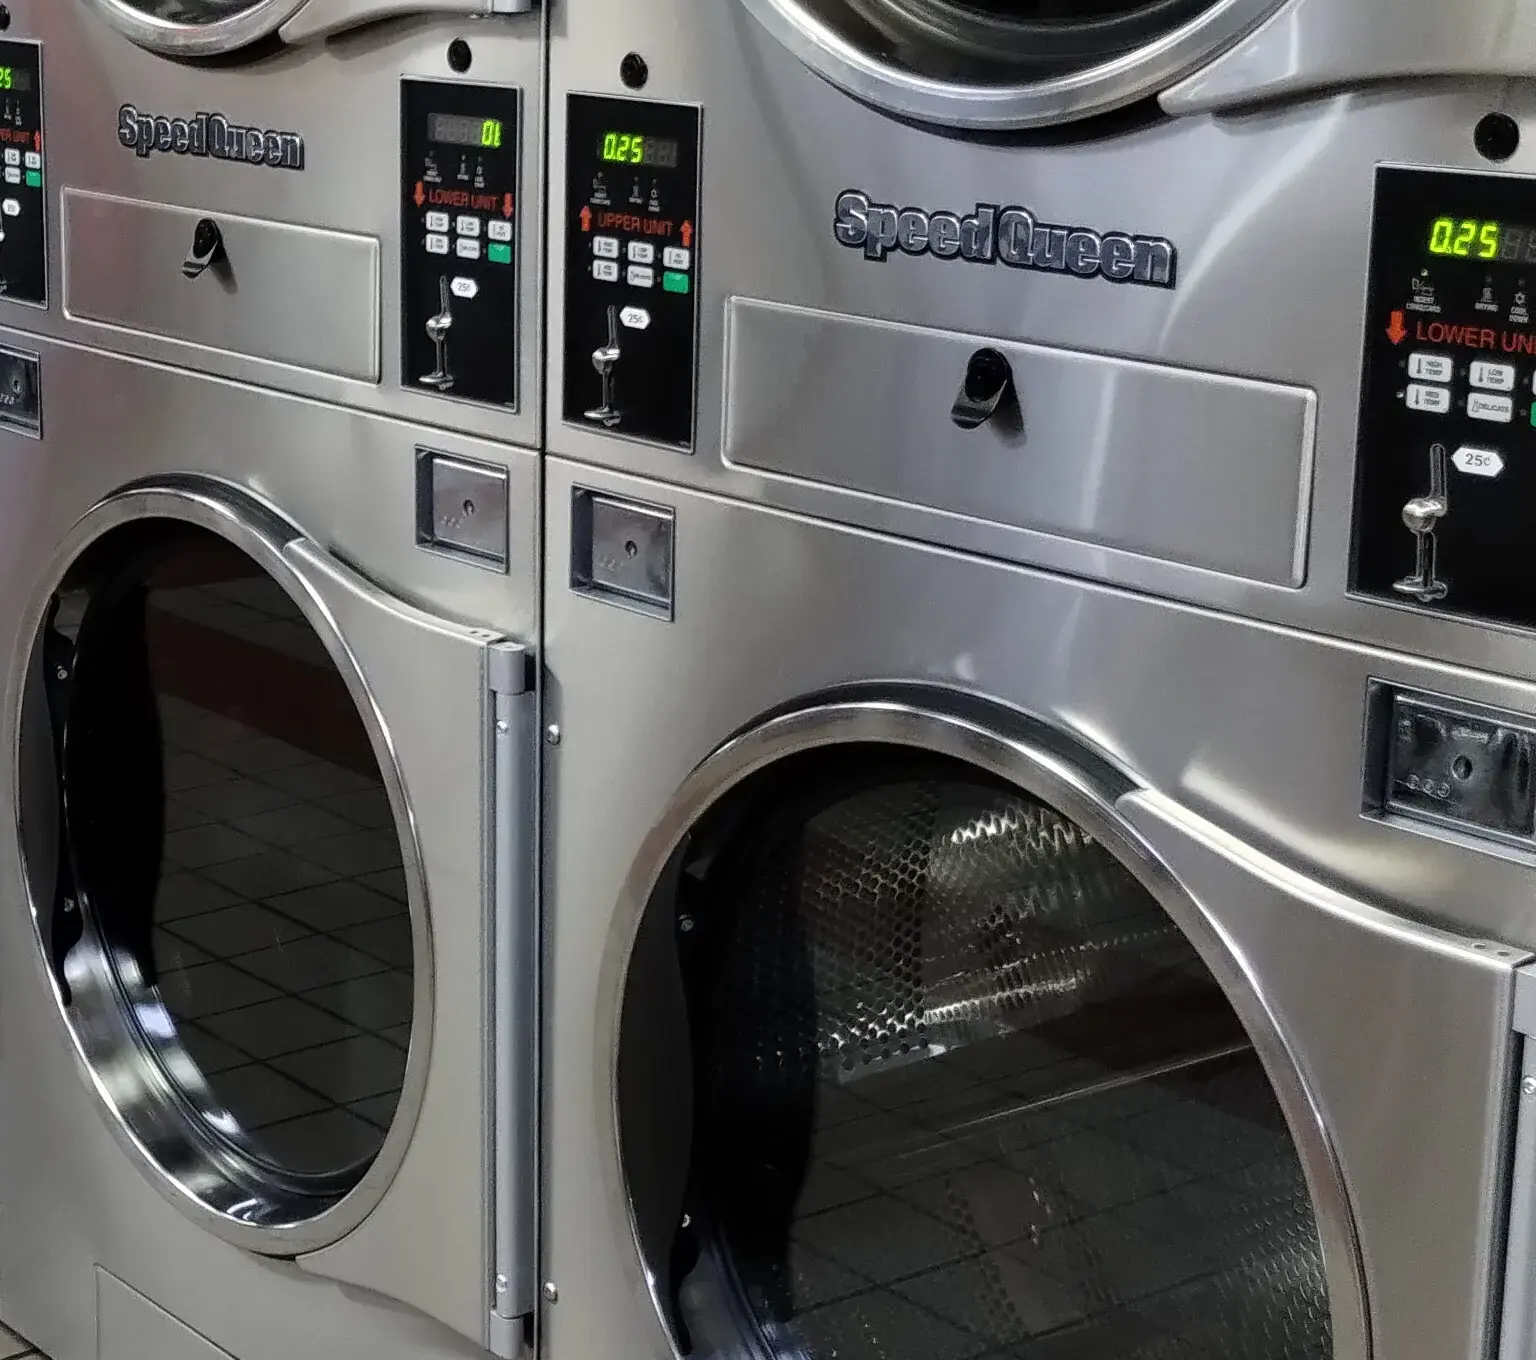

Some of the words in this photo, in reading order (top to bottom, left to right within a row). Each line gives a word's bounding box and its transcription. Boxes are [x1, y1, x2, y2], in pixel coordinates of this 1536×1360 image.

[603, 134, 644, 163] 0.25
[429, 188, 469, 206] LOWER
[471, 194, 498, 211] UNIT
[597, 212, 640, 232] UPPER
[643, 219, 673, 237] UNIT
[1429, 219, 1498, 259] 0.25
[1416, 320, 1495, 350] LOWER
[1502, 330, 1536, 355] UN
[1465, 453, 1492, 467] 25¢
